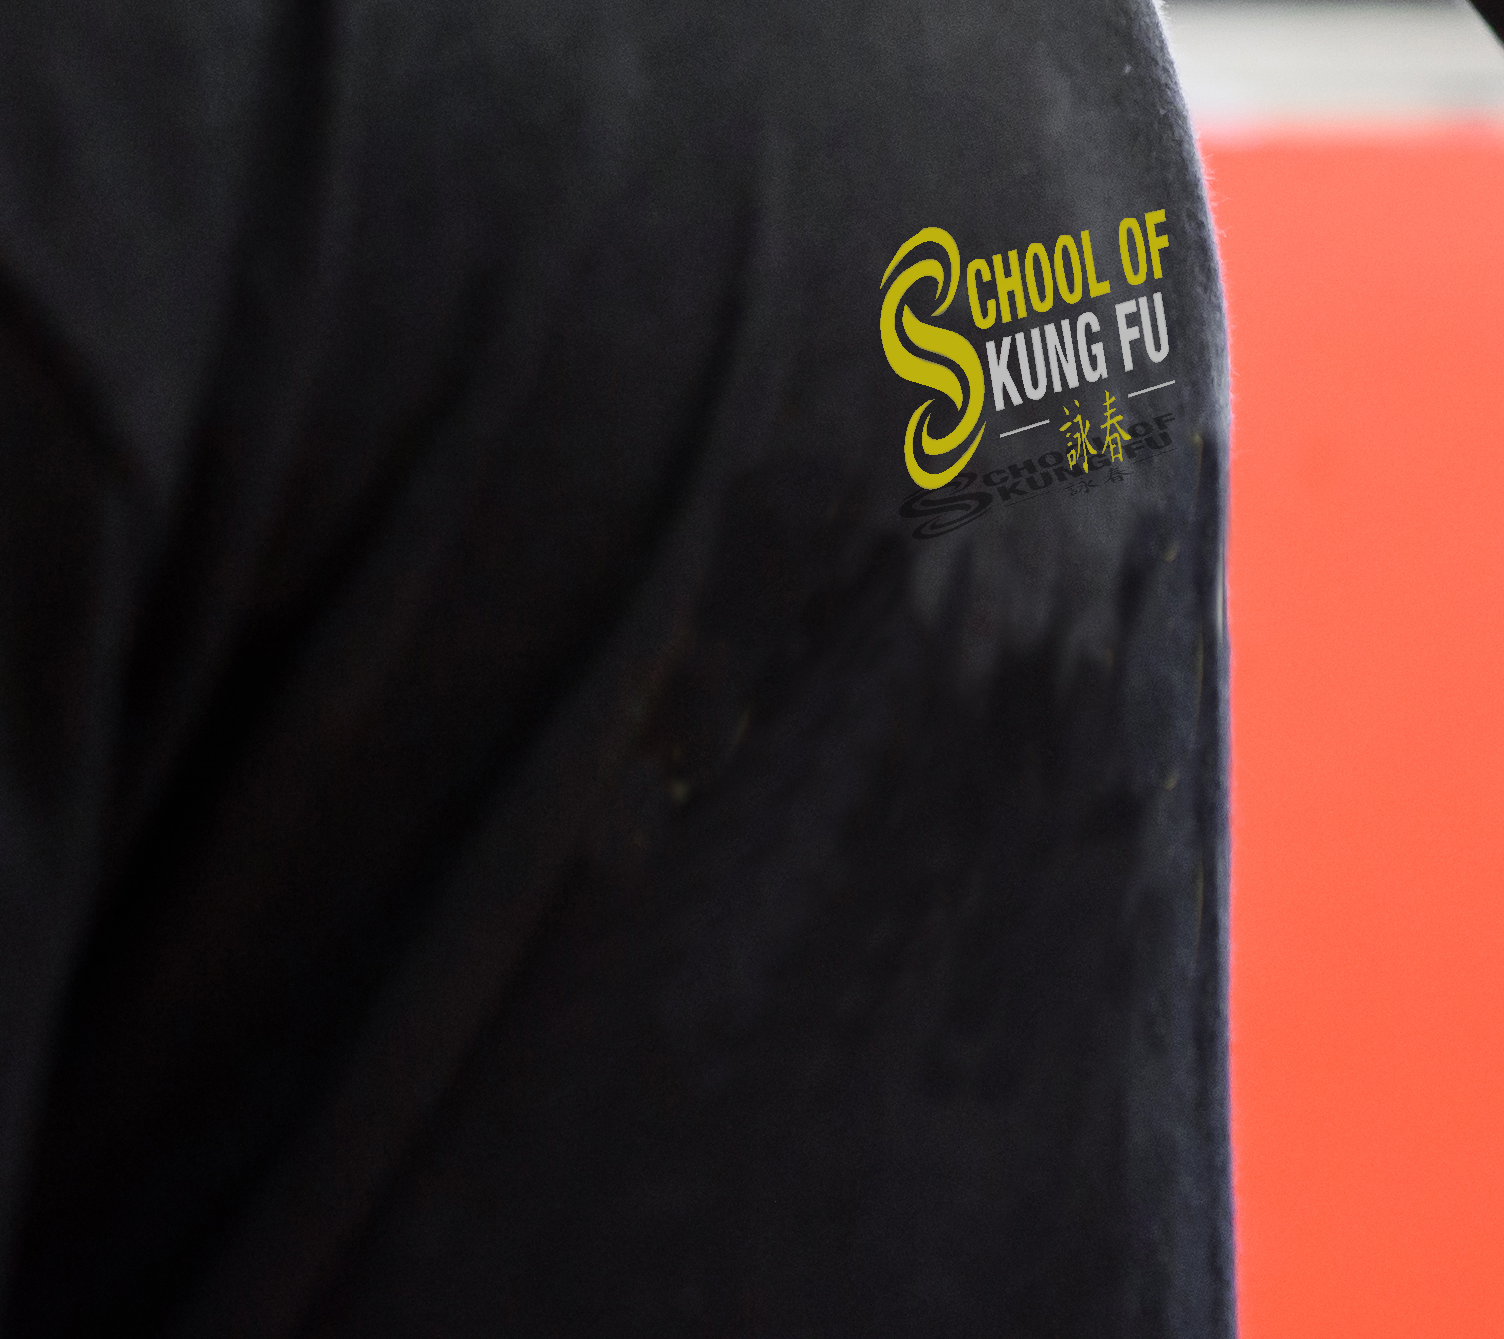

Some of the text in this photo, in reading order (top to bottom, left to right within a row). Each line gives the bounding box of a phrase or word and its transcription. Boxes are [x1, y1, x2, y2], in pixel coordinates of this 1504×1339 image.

[880, 209, 1170, 491] SCHOOL OF
[985, 291, 1170, 412] KUNG FU
